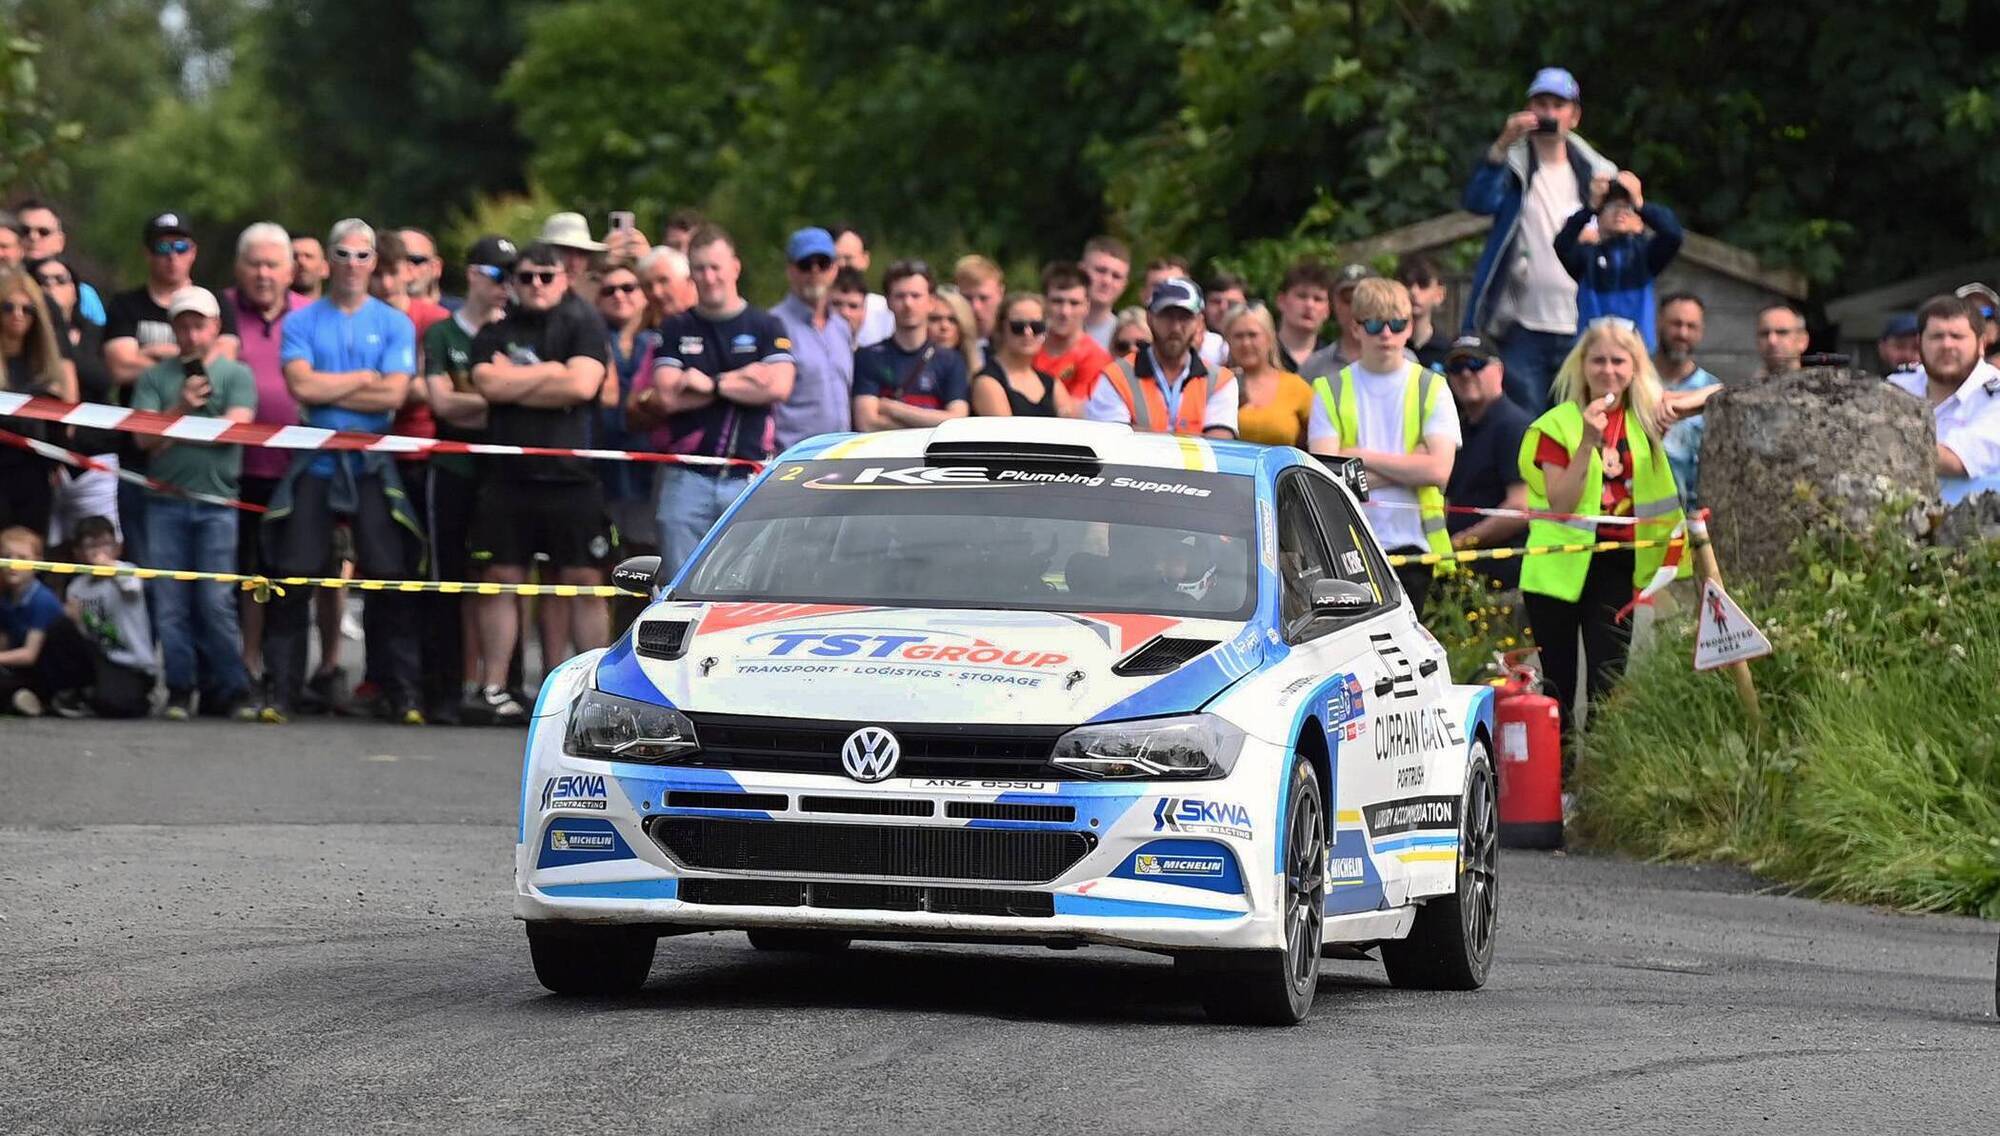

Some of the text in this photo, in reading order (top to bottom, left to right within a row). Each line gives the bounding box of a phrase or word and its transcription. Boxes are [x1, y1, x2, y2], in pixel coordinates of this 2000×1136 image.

[779, 466, 804, 481] 2
[853, 466, 1212, 498] KE Plumbing Supplies
[628, 571, 651, 581] ART
[738, 665, 1041, 688] TRANSPORT LOGISTICS STORAGE
[1375, 710, 1419, 761] CURRAN
[1420, 707, 1465, 752] GATE
[553, 775, 607, 798] SKWA
[1397, 764, 1425, 790] PORTRUSH
[553, 801, 604, 809] CONTRACTING
[1176, 799, 1252, 828] SKWA
[1392, 802, 1452, 826] ACCOMMODATION
[569, 835, 612, 846] MICHELIN
[1163, 860, 1221, 871] MICHELIN
